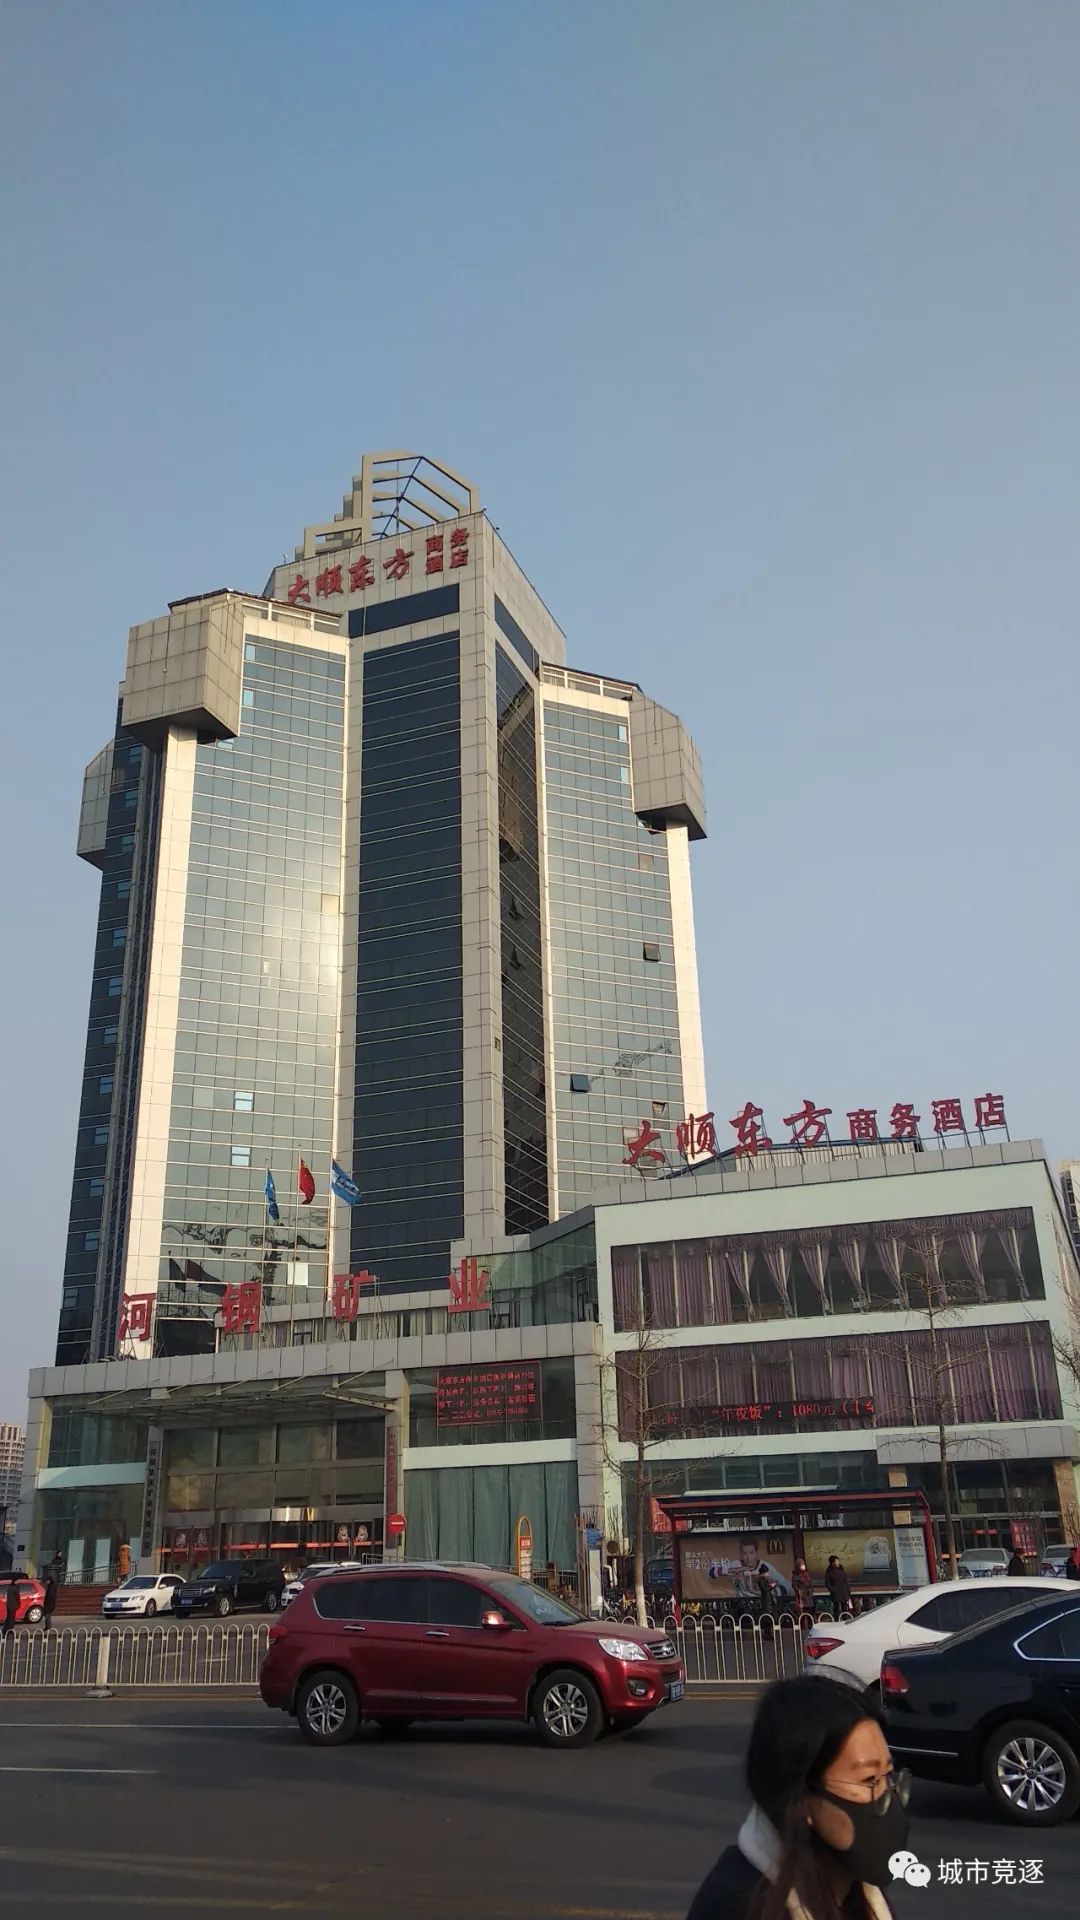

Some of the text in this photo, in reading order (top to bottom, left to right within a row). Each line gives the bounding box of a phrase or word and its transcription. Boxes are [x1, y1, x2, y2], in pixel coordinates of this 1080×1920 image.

[425, 527, 470, 554] 商务
[425, 549, 469, 575] 酒店
[286, 548, 415, 604] 大顺东方
[622, 1092, 1007, 1165] 大顺东方商务酒店
[118, 1258, 491, 1342] 河钢矿业
